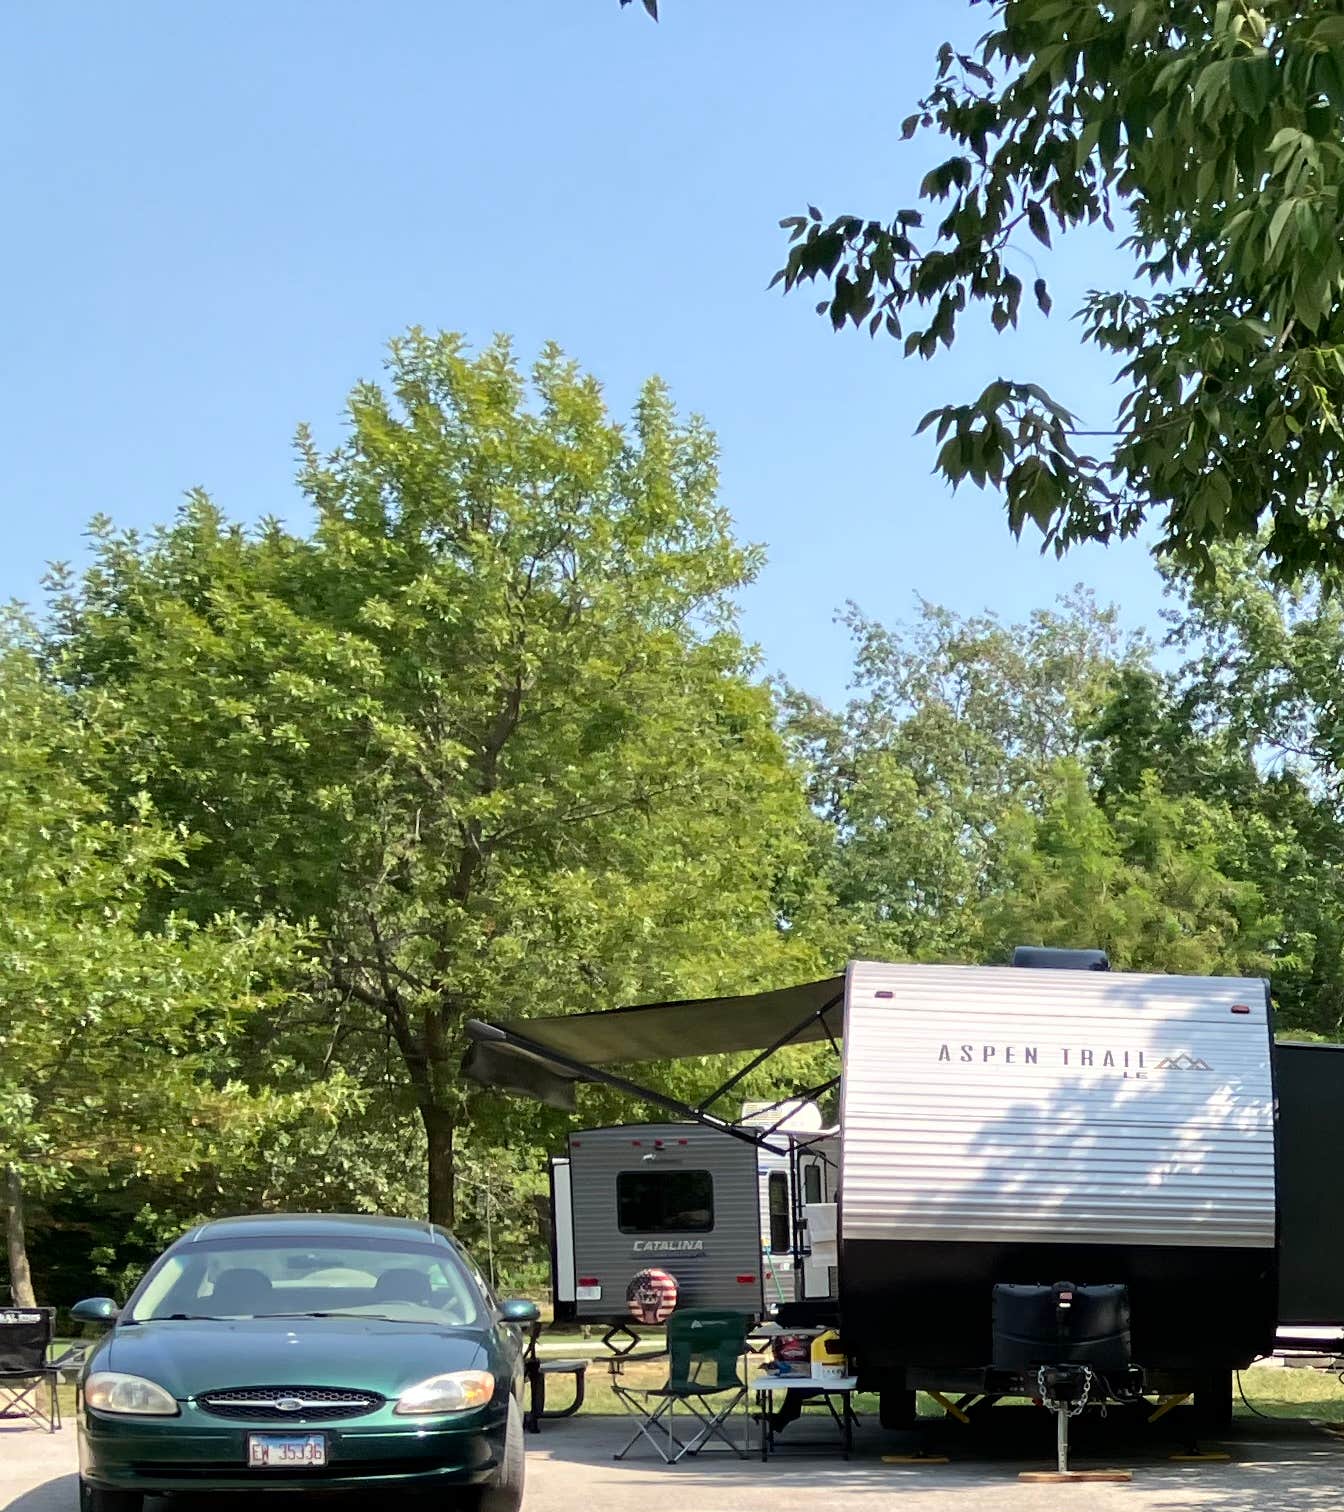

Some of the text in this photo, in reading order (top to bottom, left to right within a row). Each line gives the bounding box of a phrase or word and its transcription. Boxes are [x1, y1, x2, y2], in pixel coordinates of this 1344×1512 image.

[938, 1044, 1146, 1069] ASPEN TRAIL
[633, 1240, 704, 1252] CATALINA
